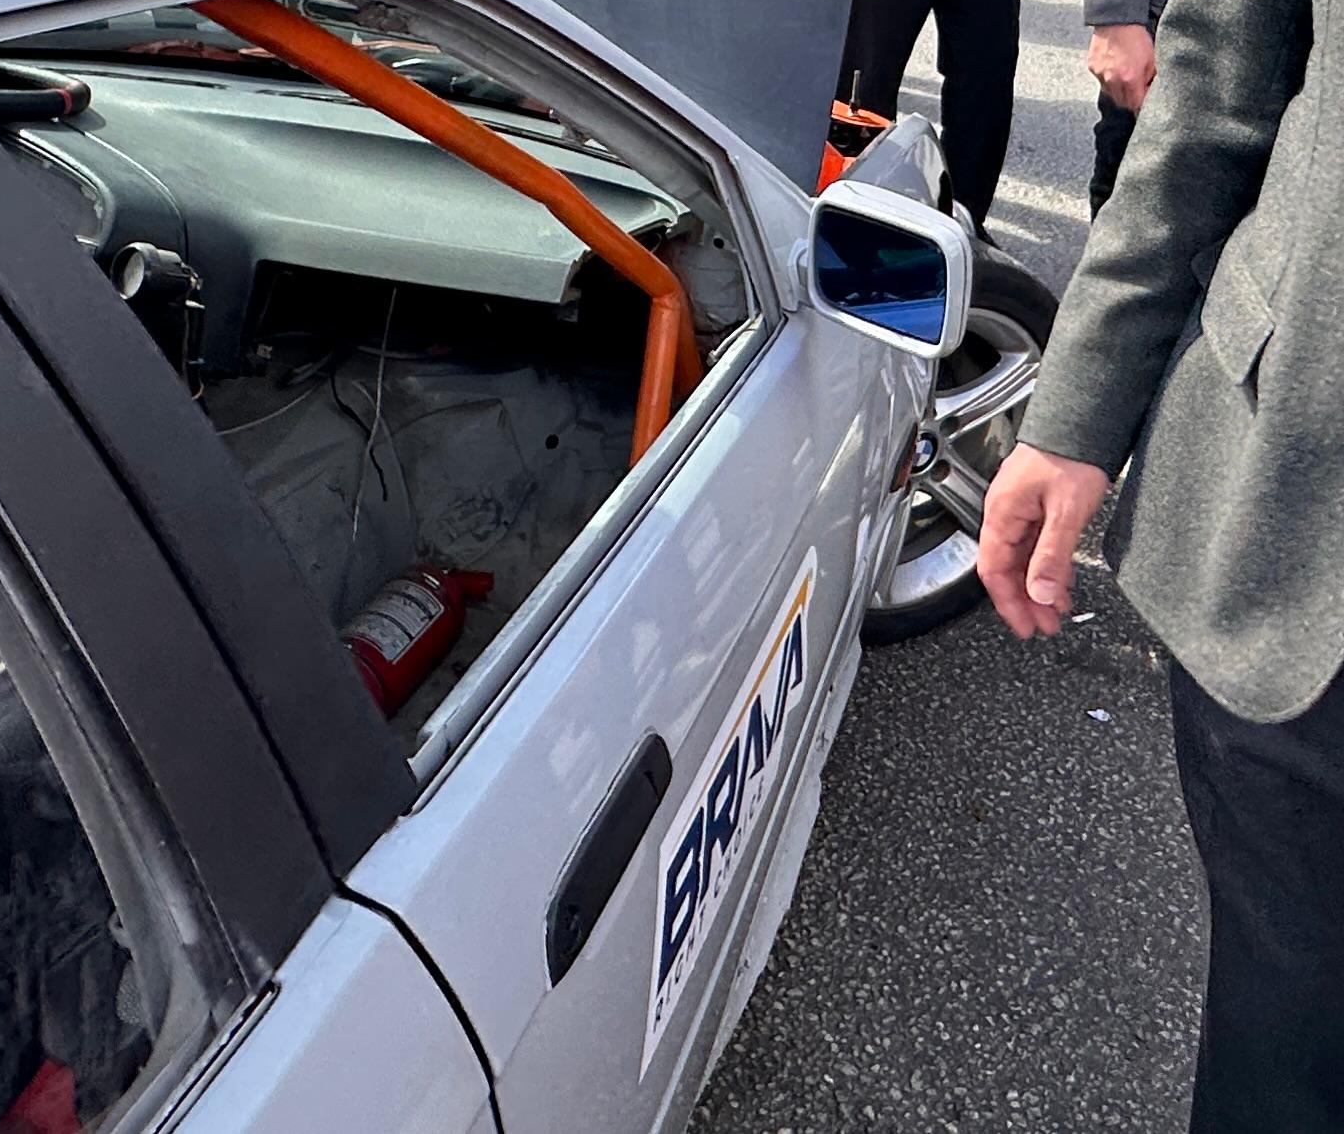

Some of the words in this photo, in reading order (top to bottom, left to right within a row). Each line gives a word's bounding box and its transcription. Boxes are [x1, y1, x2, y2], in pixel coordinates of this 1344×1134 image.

[652, 902, 707, 1034] RIGHT
[712, 772, 765, 899] CHOICE
[657, 611, 804, 997] BRAVA
